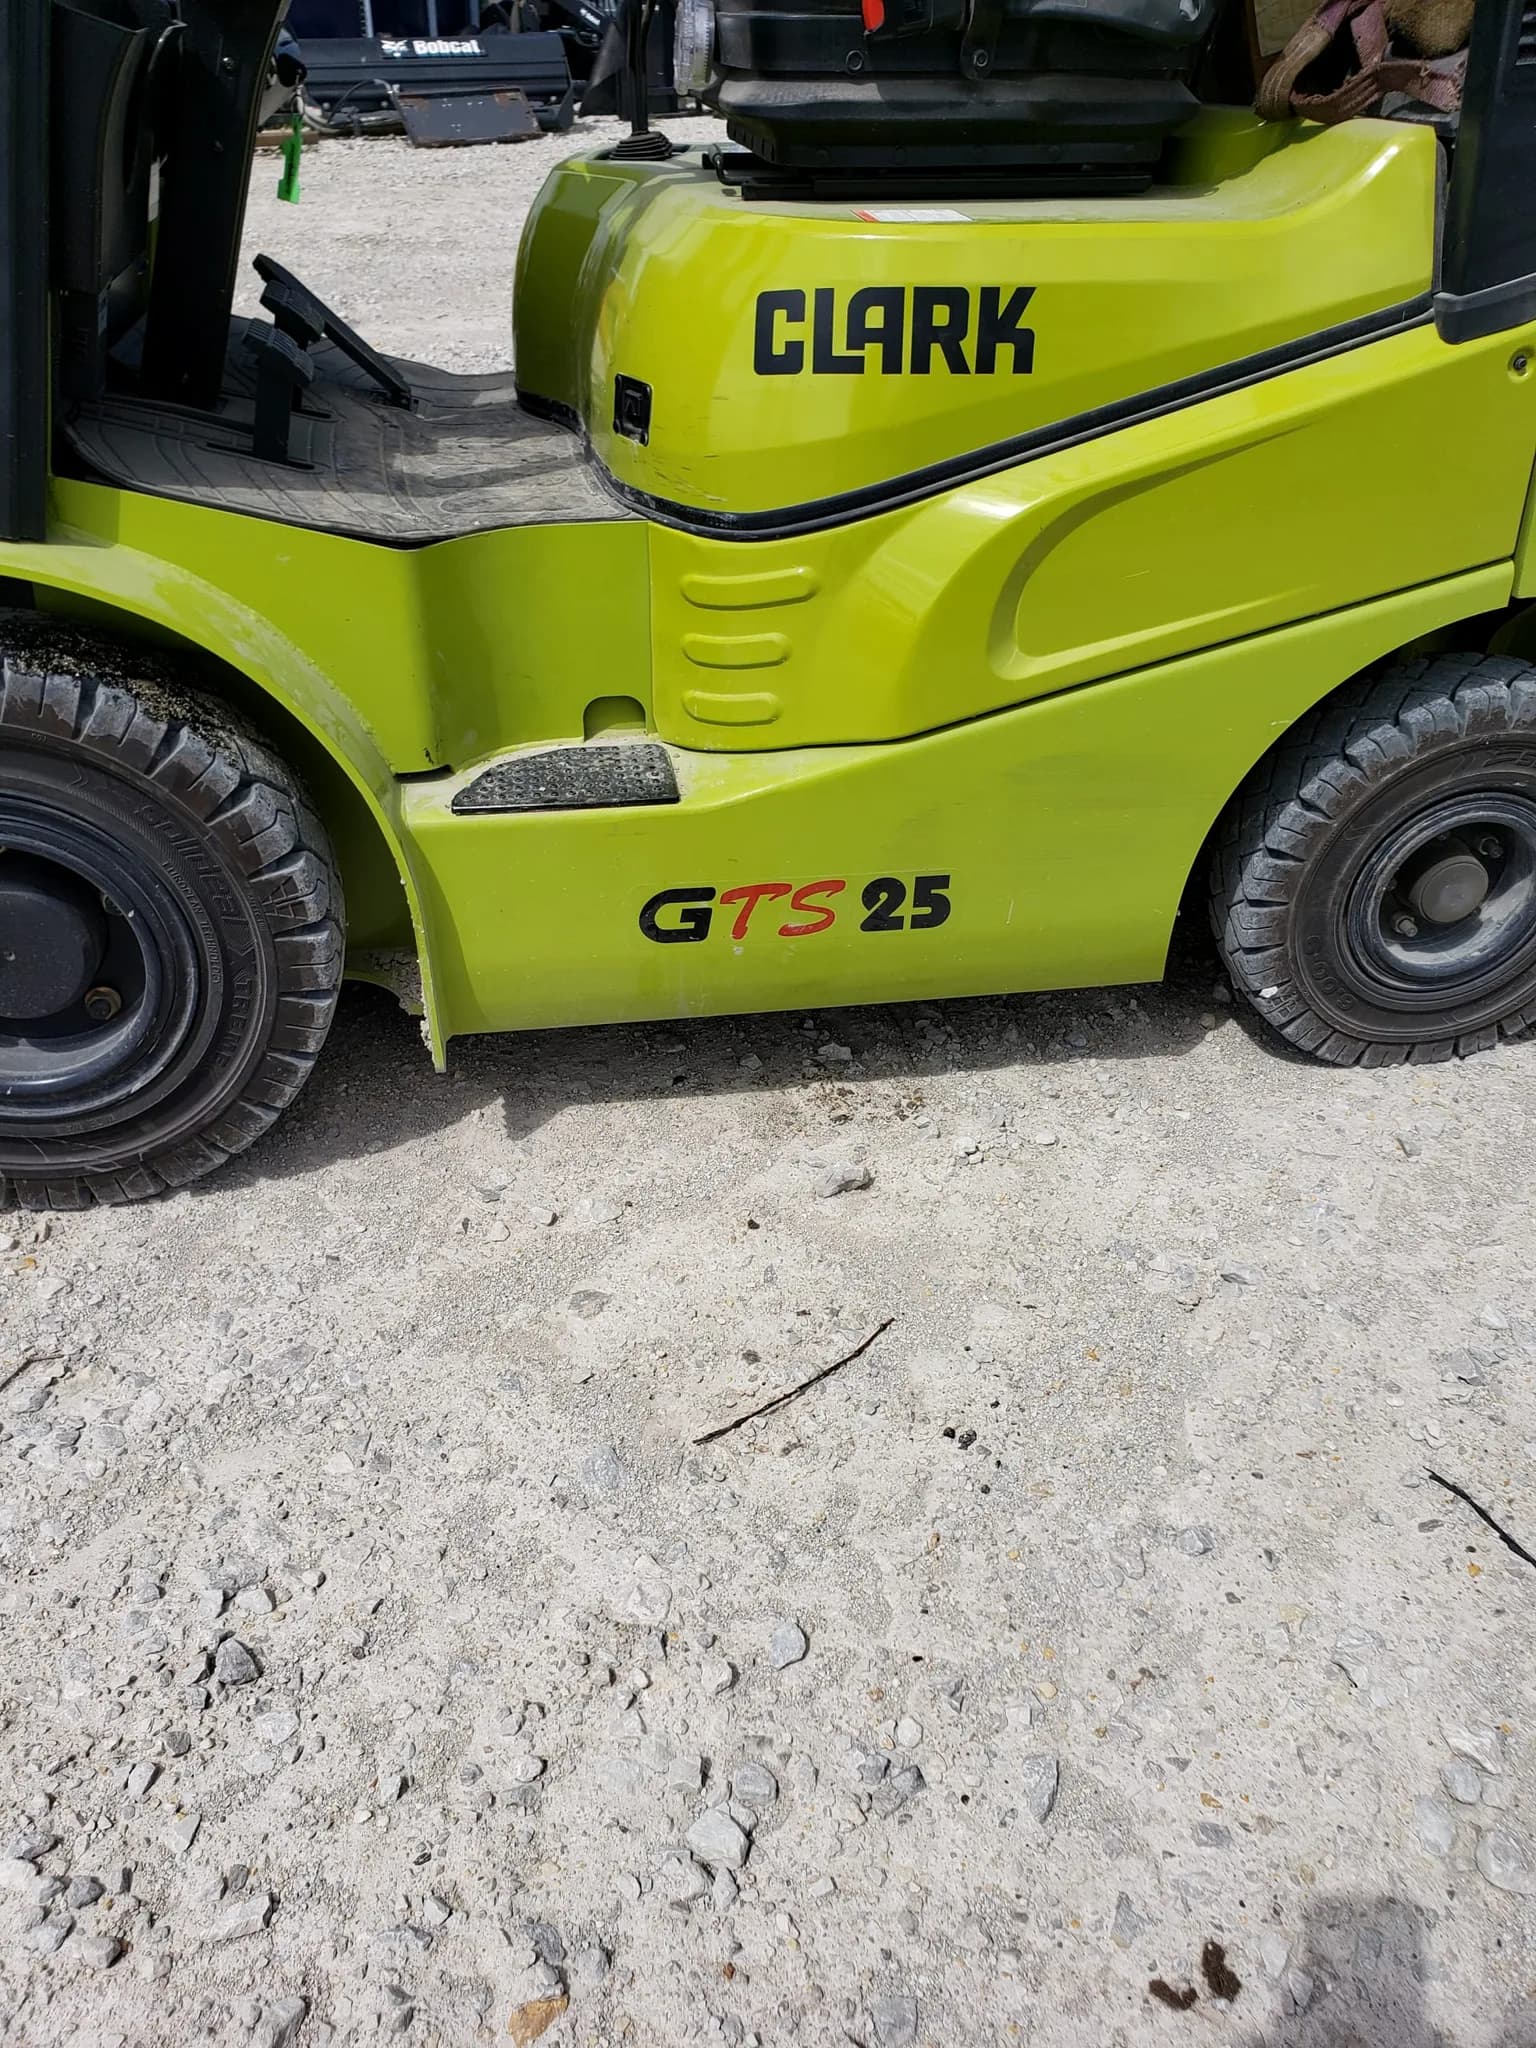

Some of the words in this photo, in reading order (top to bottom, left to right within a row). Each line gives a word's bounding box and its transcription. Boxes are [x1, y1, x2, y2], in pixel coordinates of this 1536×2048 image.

[413, 39, 480, 55] Bobcat
[753, 286, 1036, 375] CLARK
[638, 880, 846, 944] GTS
[860, 875, 951, 932] 25
